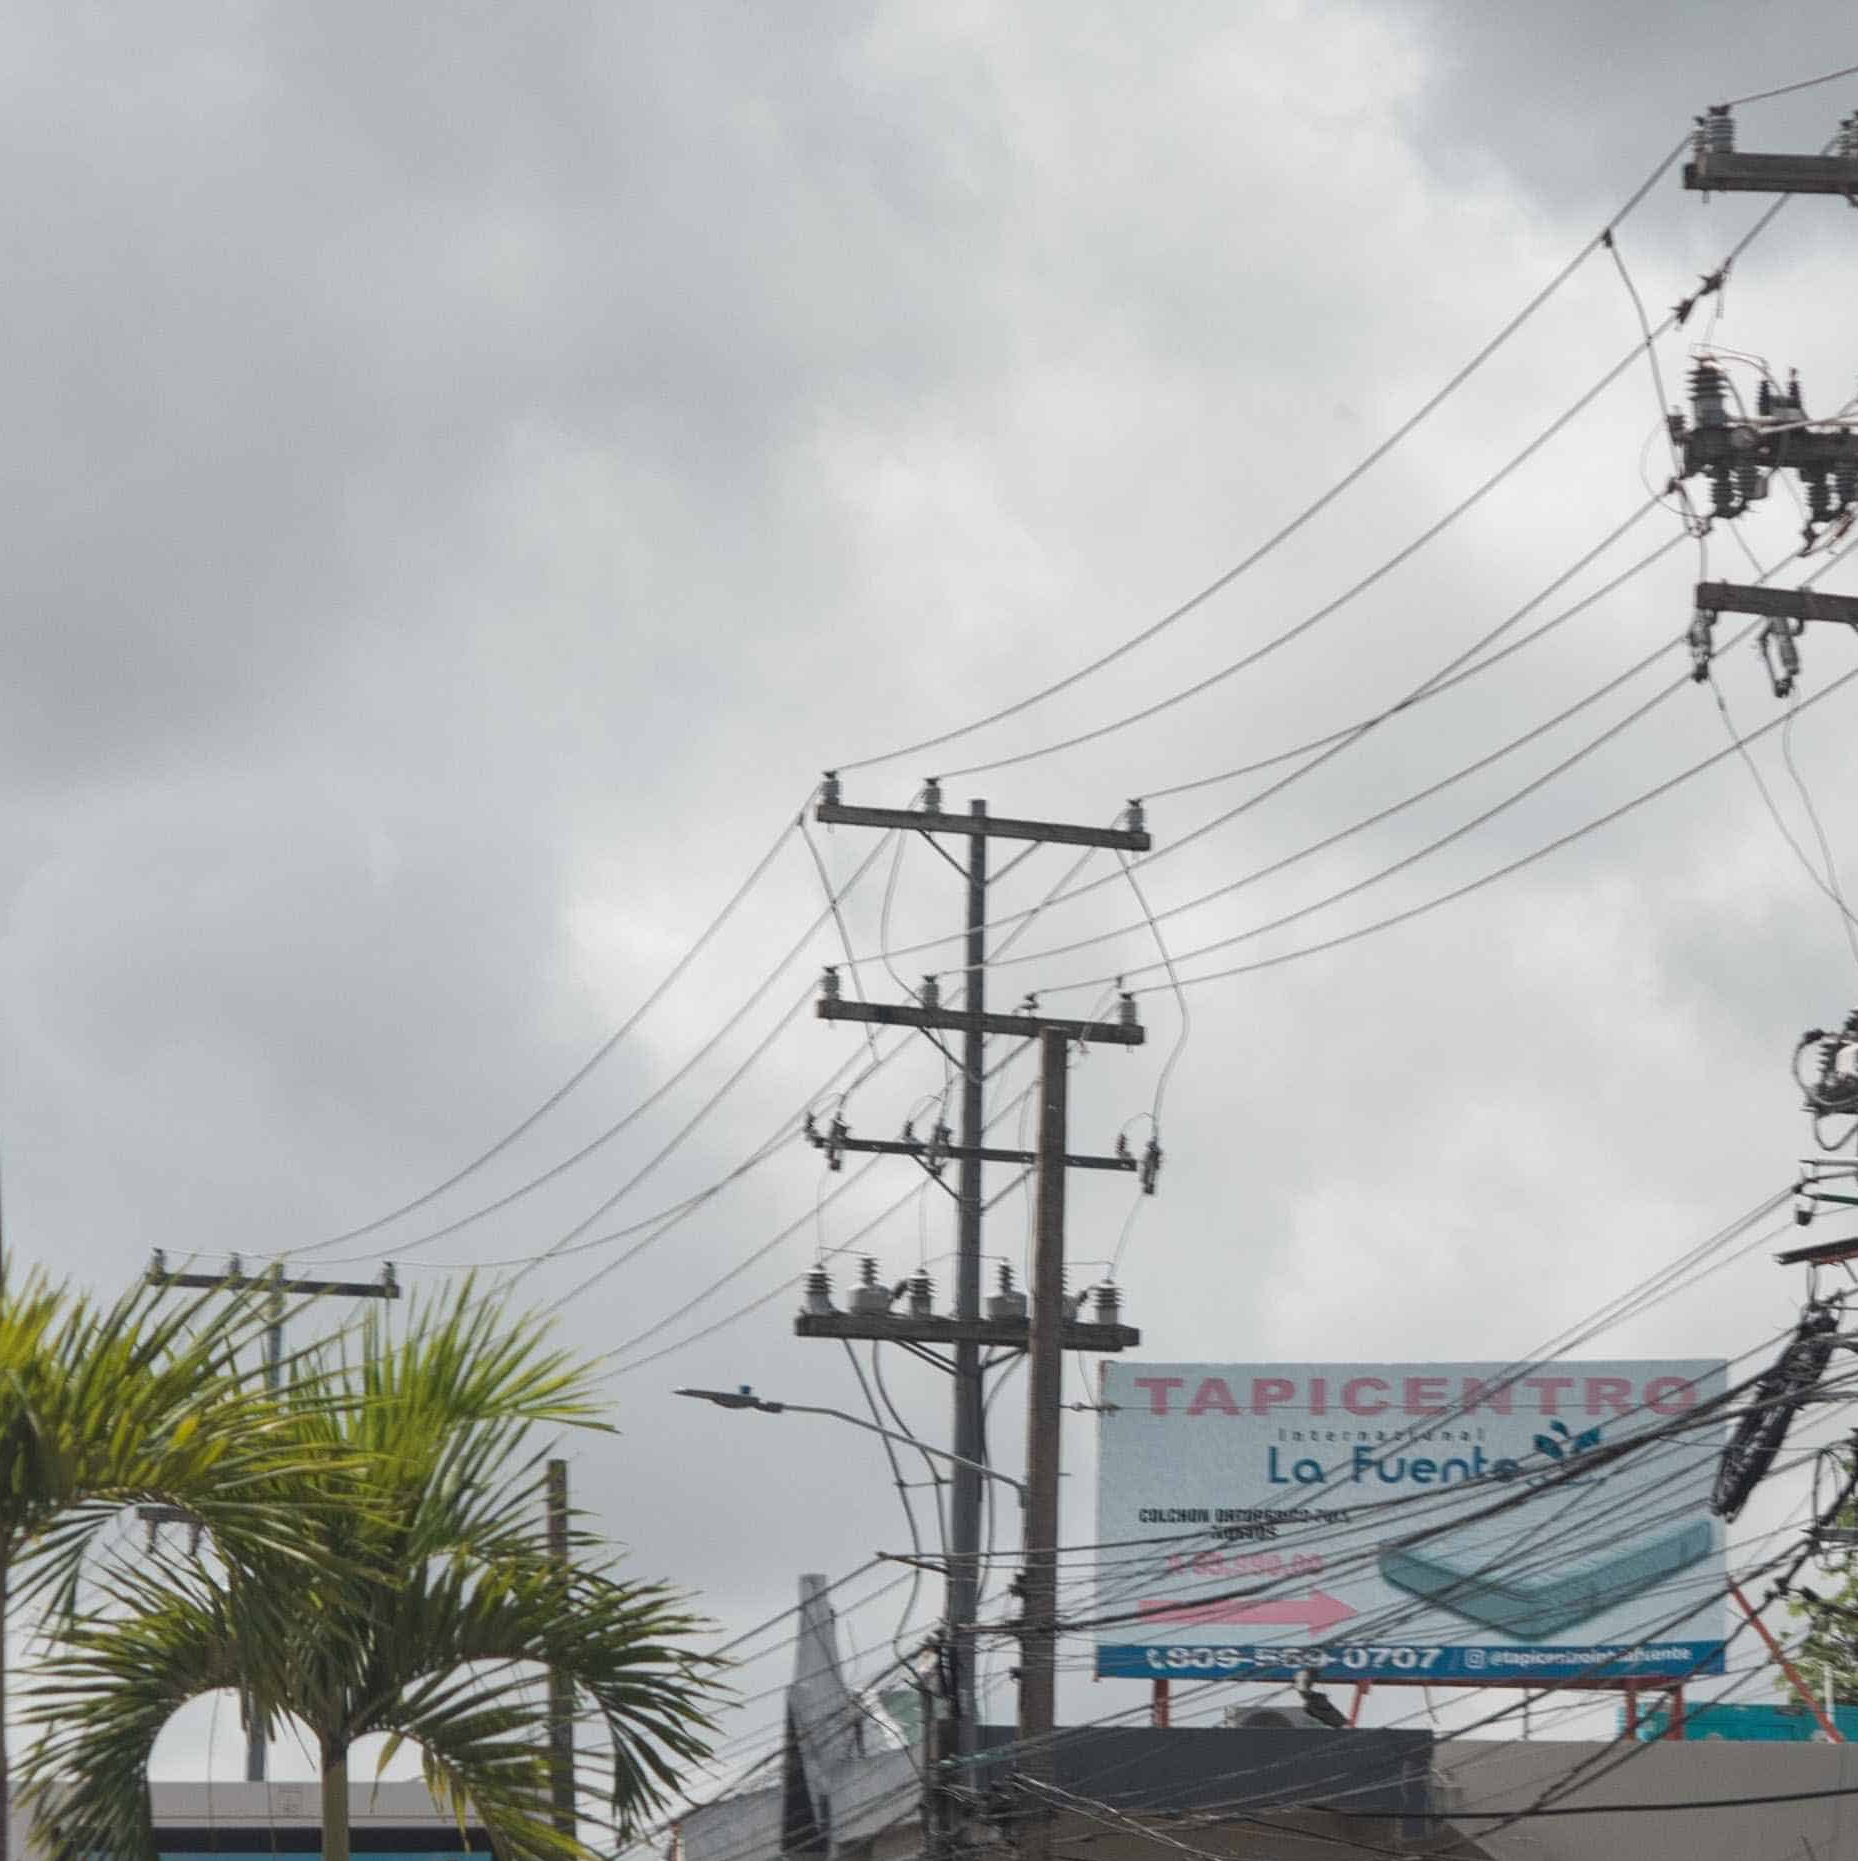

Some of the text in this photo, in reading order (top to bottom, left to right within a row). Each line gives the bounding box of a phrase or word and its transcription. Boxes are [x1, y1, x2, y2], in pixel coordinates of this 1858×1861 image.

[1133, 1376, 1697, 1416] TAPICENTRO
[1267, 1445, 1519, 1484] La Fuente
